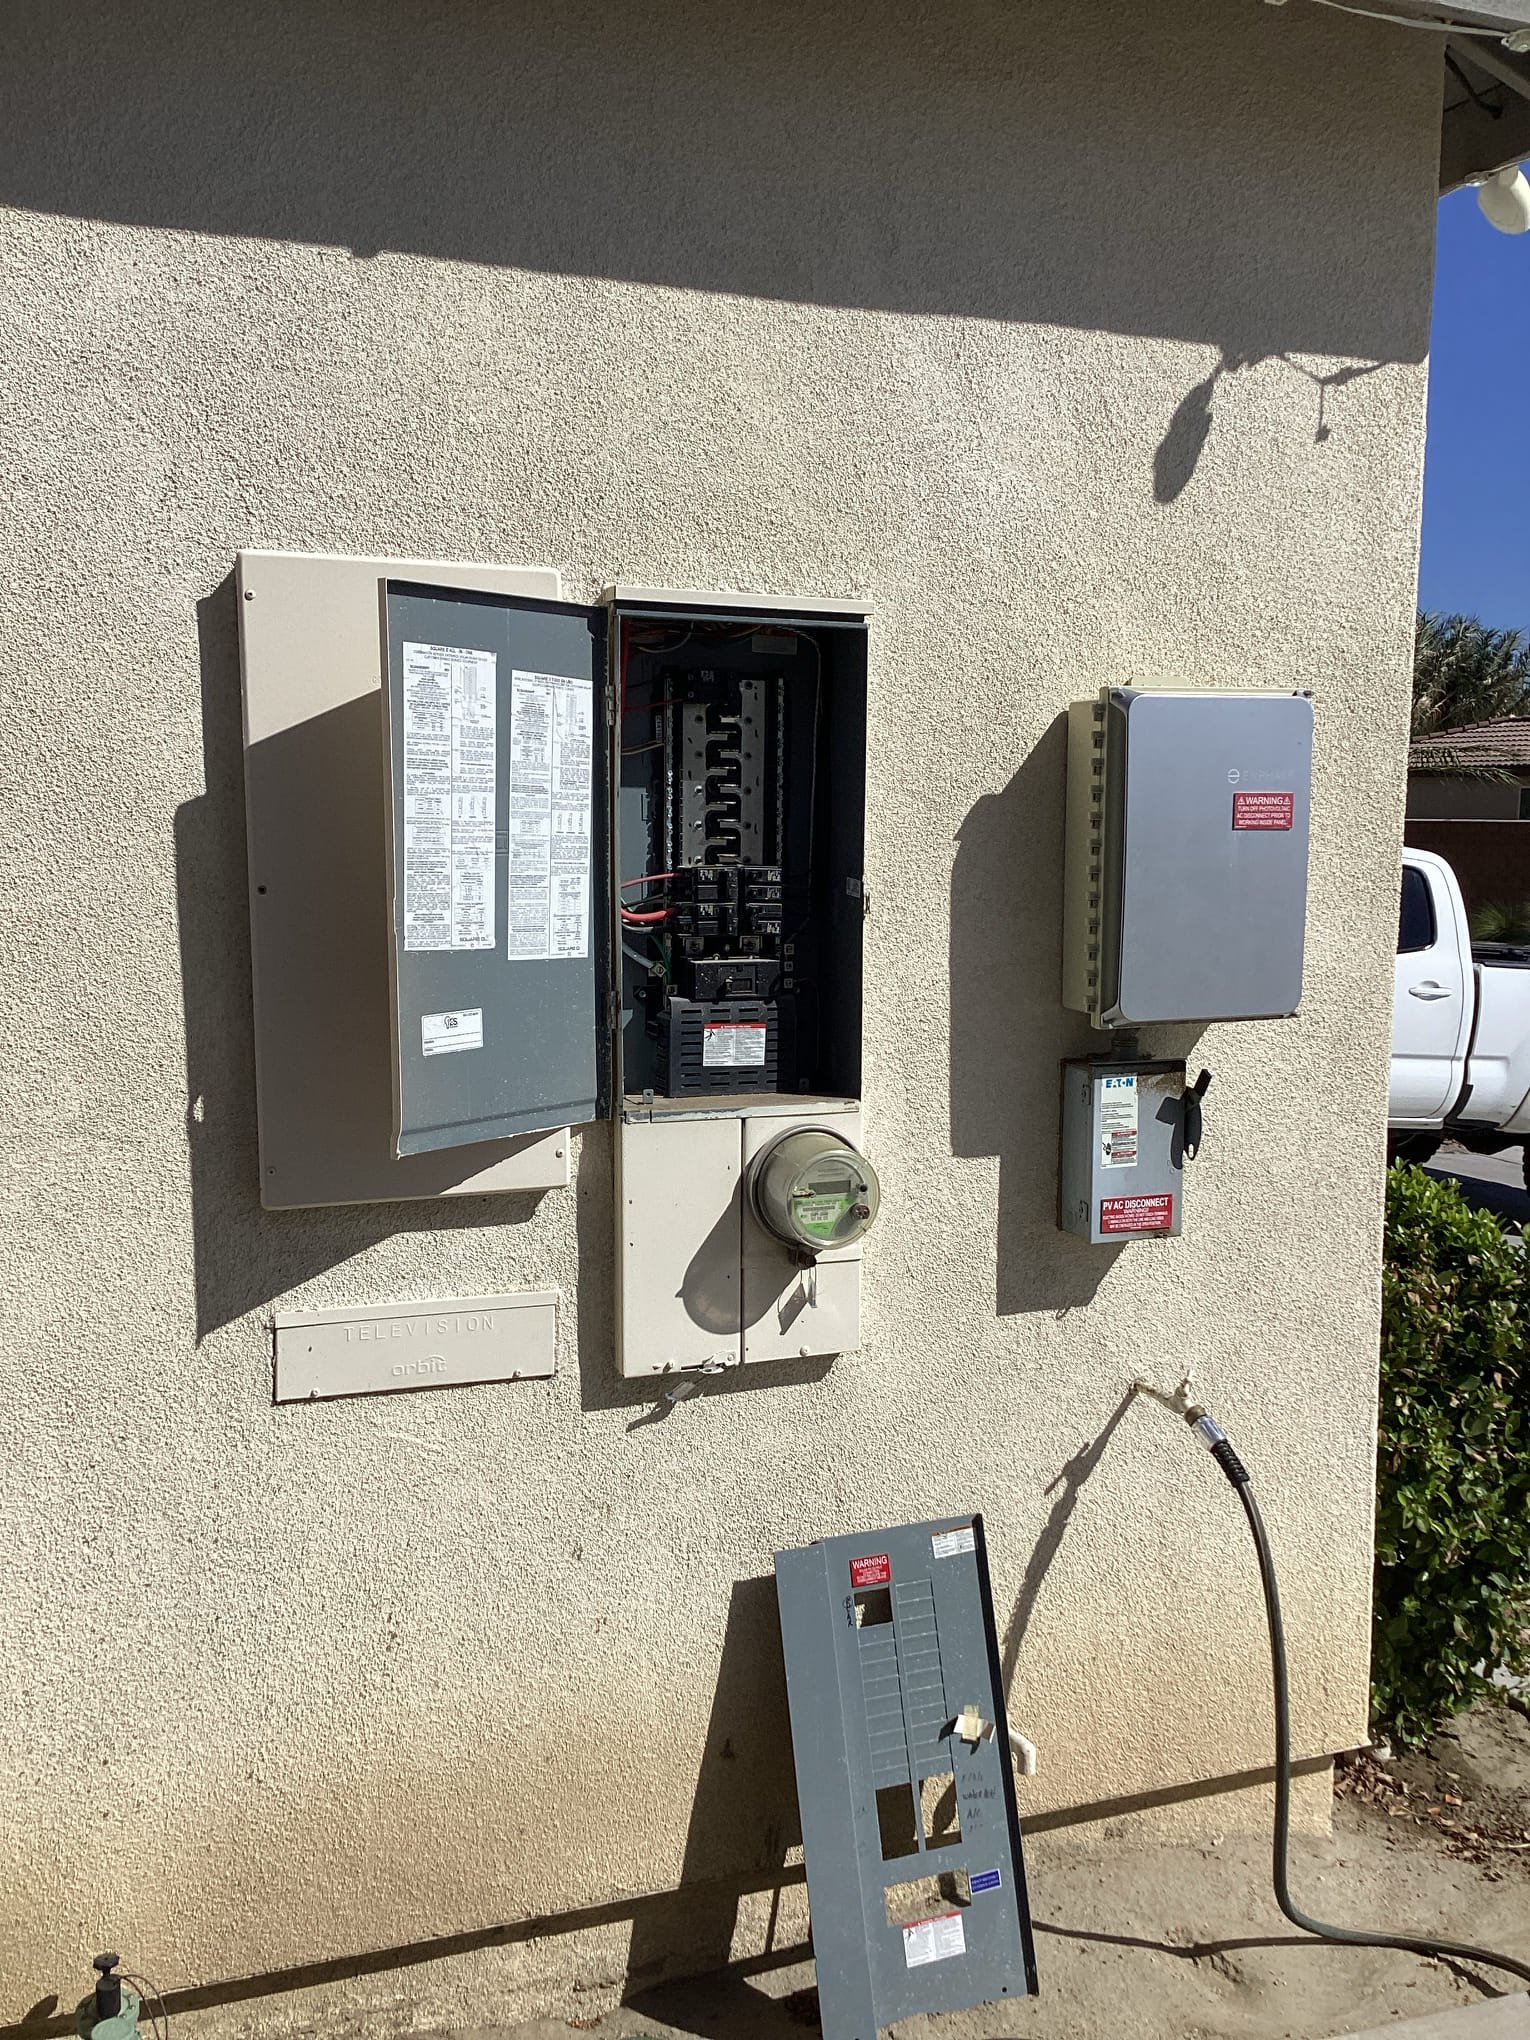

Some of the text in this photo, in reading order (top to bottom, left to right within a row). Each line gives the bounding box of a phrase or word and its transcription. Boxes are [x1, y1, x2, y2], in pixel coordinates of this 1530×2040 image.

[1245, 796, 1283, 805] WARNING
[1106, 1078, 1133, 1088] EATON
[1103, 1197, 1169, 1210] PV AC DISCONNECT
[344, 1315, 494, 1342] TELEVISION
[392, 1354, 447, 1377] orbit
[852, 1556, 887, 1569] WARNING
